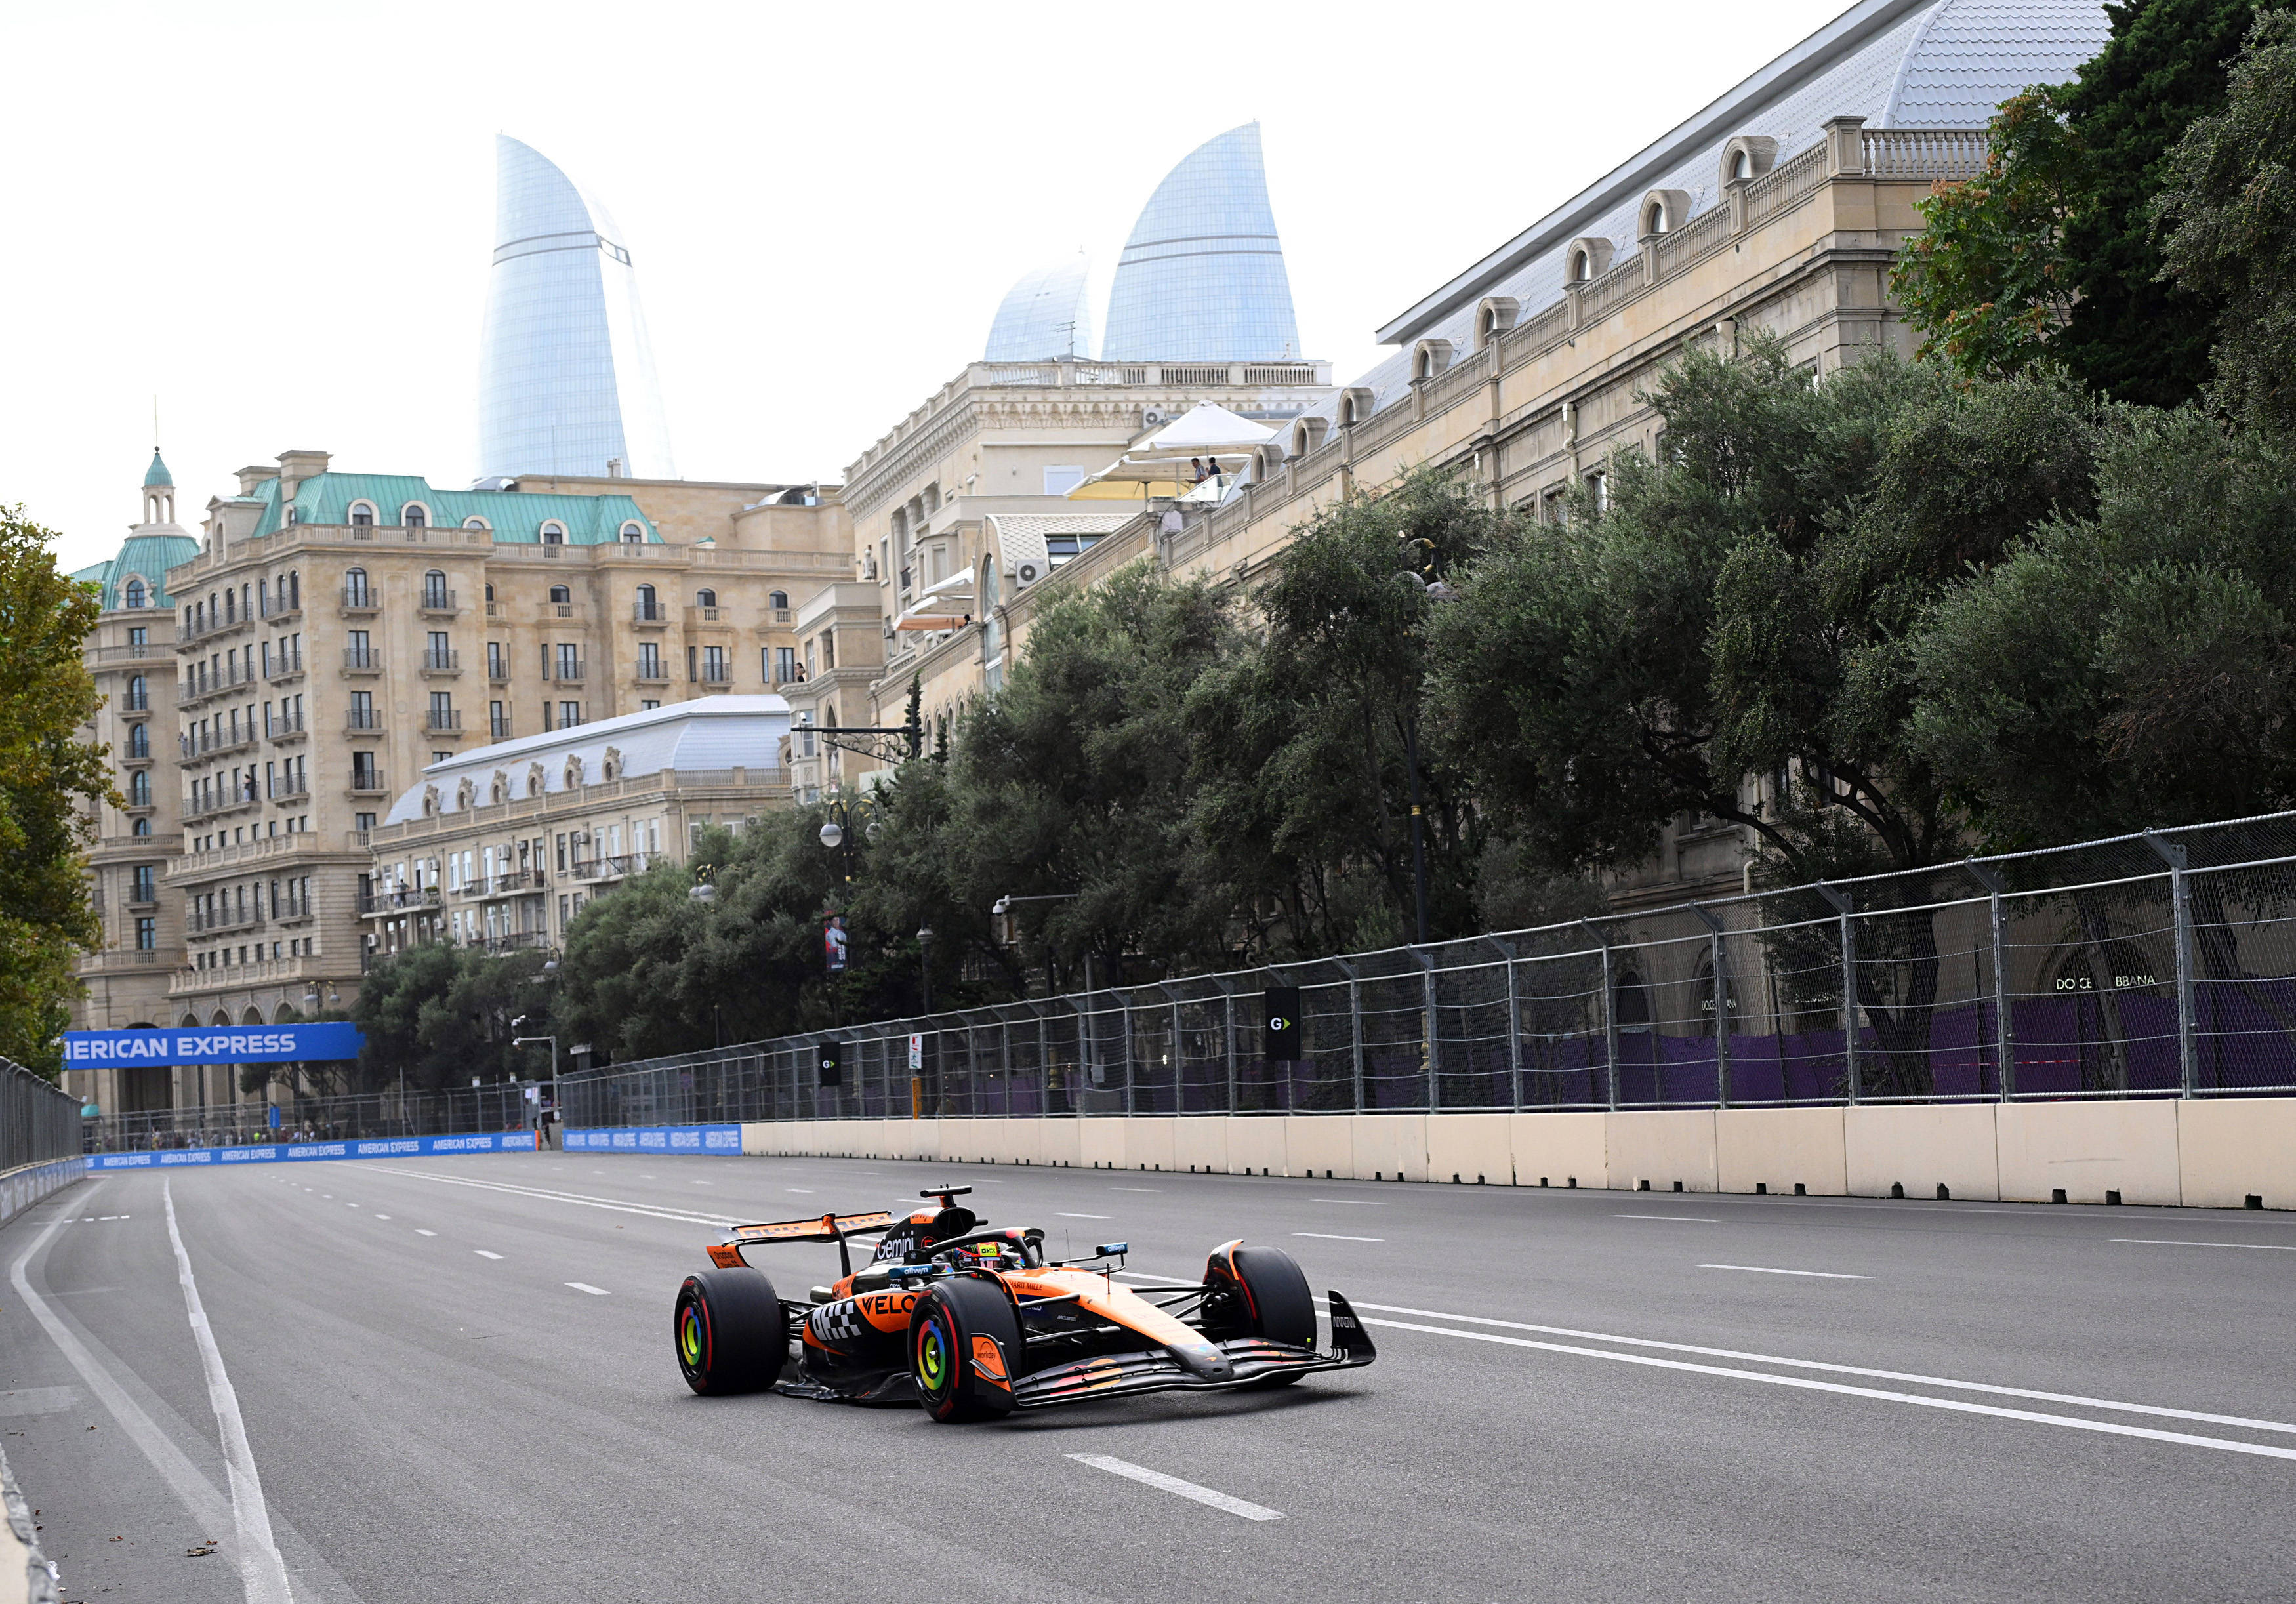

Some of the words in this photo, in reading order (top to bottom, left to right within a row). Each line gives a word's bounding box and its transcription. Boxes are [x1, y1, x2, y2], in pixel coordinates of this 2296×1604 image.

[2057, 977, 2092, 990] DOCE
[2116, 975, 2155, 987] BBANA
[177, 1033, 296, 1056] EXPRESS
[318, 1145, 346, 1155] EXPRESS
[358, 1142, 389, 1153] AMERICAN
[390, 1141, 419, 1151] EXPRESS
[433, 1140, 465, 1150] AMERICAN
[466, 1138, 492, 1148] EXPRESS
[250, 1149, 276, 1159] EXPRESS
[877, 1230, 914, 1260] Gemini
[1027, 1283, 1044, 1291] MILLE
[863, 1294, 916, 1315] VELO
[977, 1351, 996, 1361] workday
